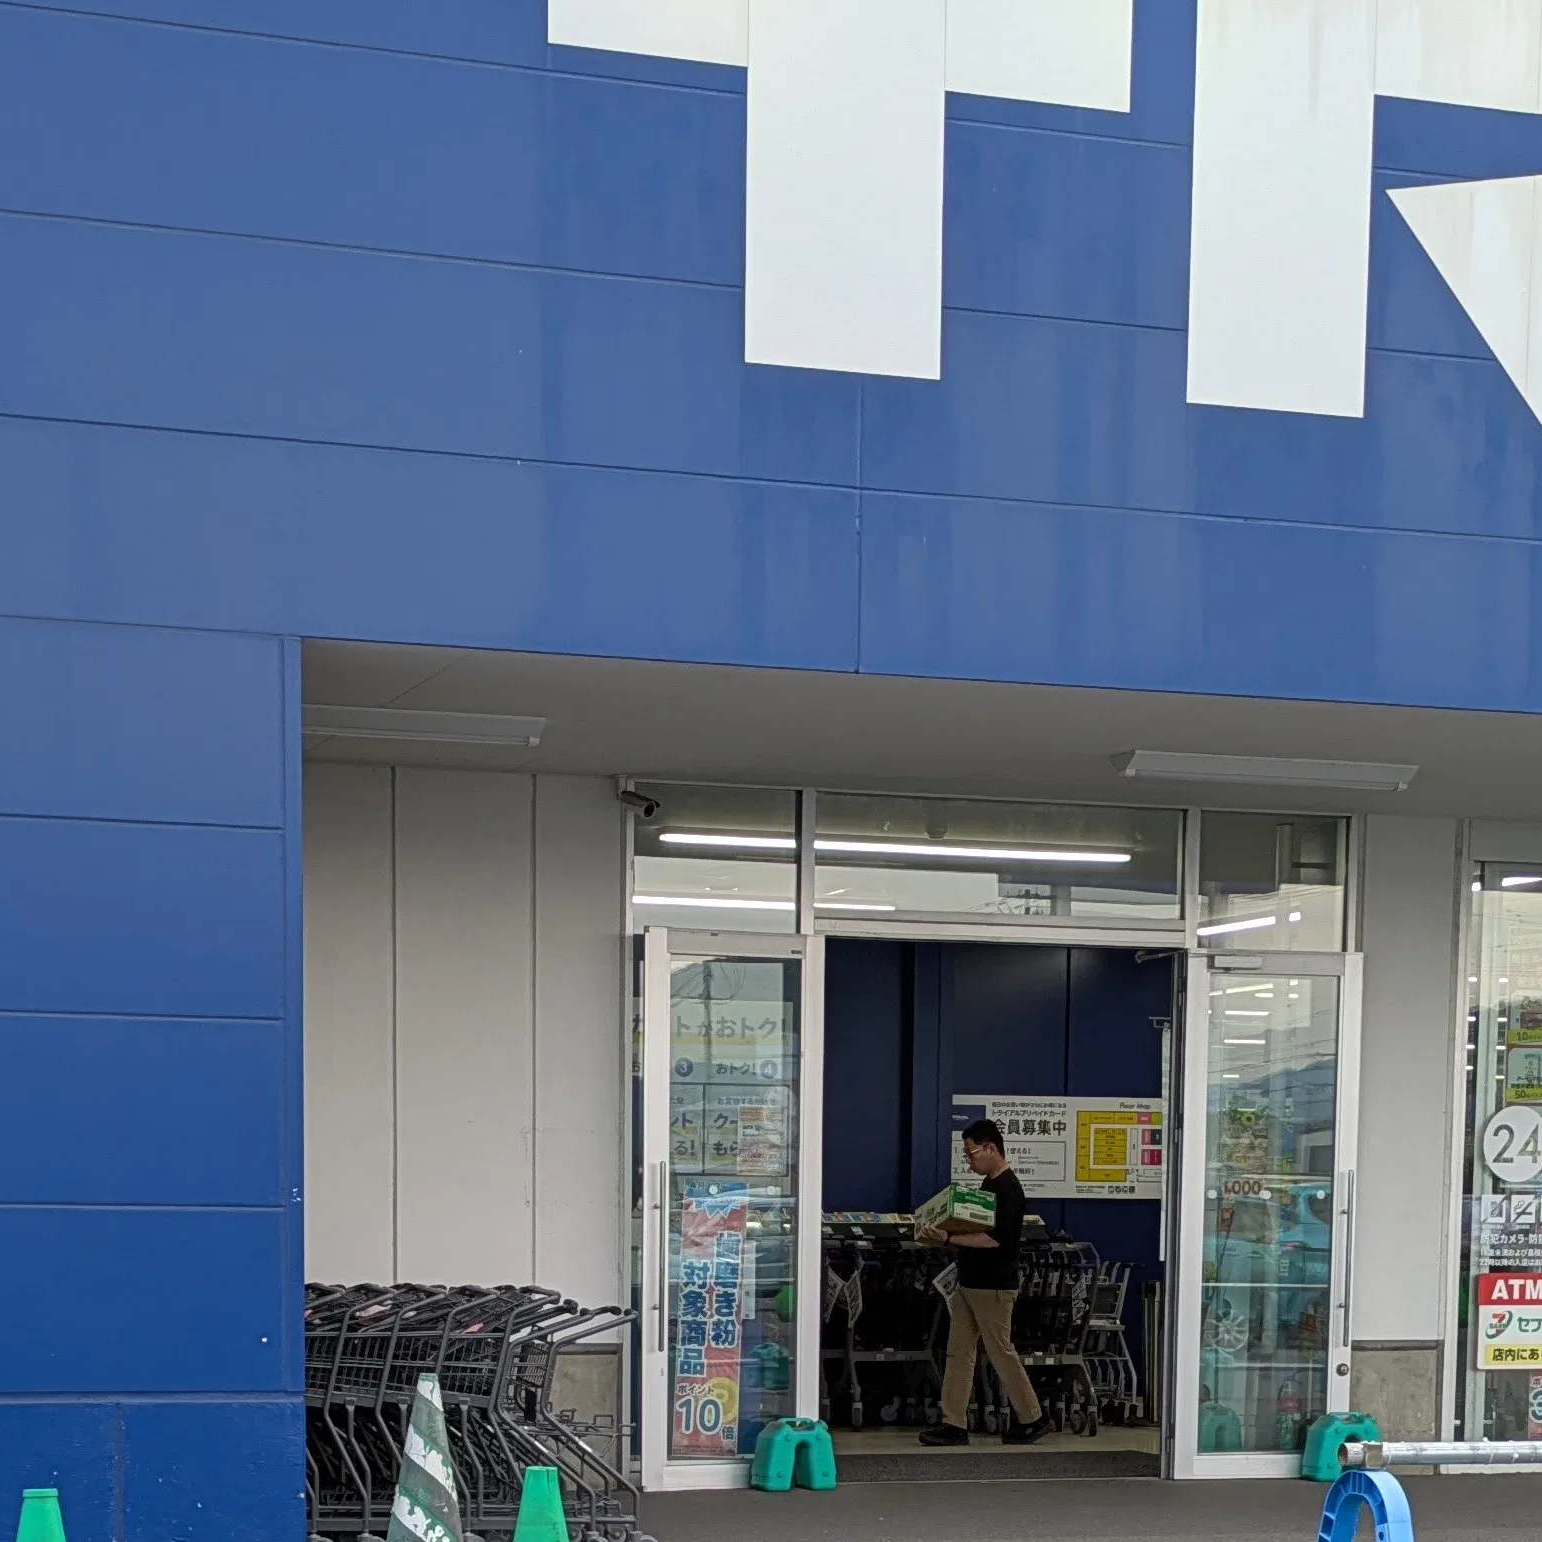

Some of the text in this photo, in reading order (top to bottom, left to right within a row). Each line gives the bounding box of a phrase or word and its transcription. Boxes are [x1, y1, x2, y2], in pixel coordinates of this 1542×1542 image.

[996, 1119, 1067, 1136] 会員募集中
[1492, 1123, 1542, 1164] 24
[710, 1231, 743, 1348] 歯磨き粉
[677, 1259, 712, 1377] 対象商品
[676, 1382, 716, 1396] ポイント
[675, 1395, 724, 1435] 10
[721, 1425, 737, 1442] 倍
